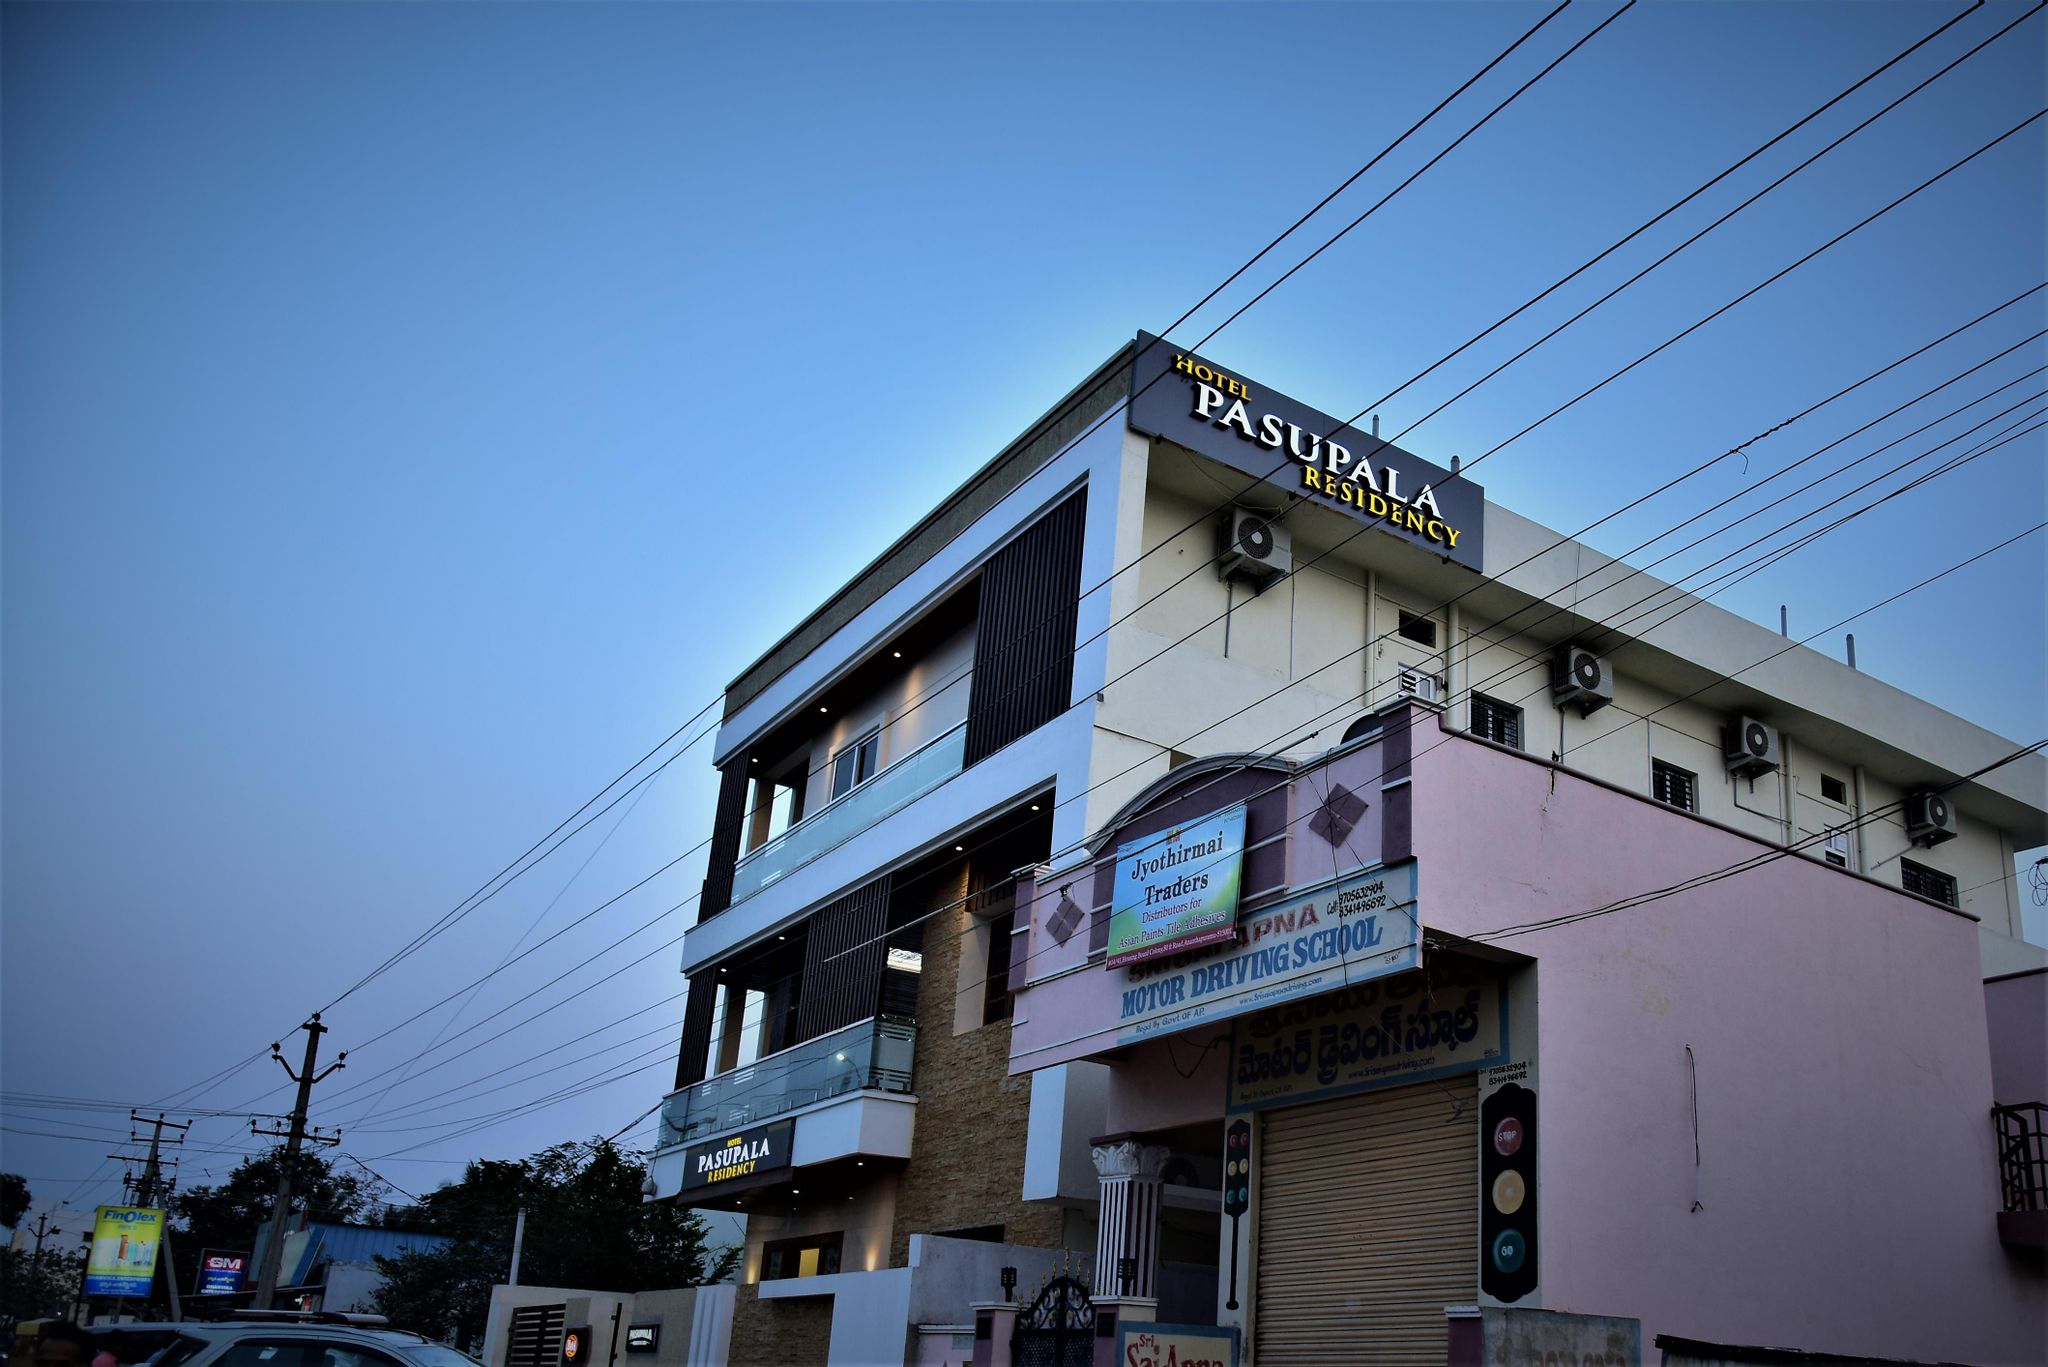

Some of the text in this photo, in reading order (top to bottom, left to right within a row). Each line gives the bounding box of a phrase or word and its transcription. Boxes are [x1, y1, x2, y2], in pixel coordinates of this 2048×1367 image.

[1174, 353, 1252, 402] HOTEL
[1194, 381, 1444, 519] PASUPALA
[1302, 465, 1462, 548] RESIDENCY
[1131, 830, 1223, 882] Jyothirmai
[1144, 874, 1209, 906] Traders
[1142, 897, 1202, 924] Distributors for
[1119, 911, 1227, 949] Asian Paints Tile Adhesives
[1121, 915, 1384, 1019] MOTOR DRIVING SCHOOL
[1162, 1012, 1181, 1027] Govt
[1497, 1129, 1517, 1141] STOP
[697, 1137, 770, 1173] PASUPALA
[707, 1160, 756, 1184] RESIDENCY
[208, 1255, 241, 1270] GM
[1139, 1334, 1155, 1348] Sri
